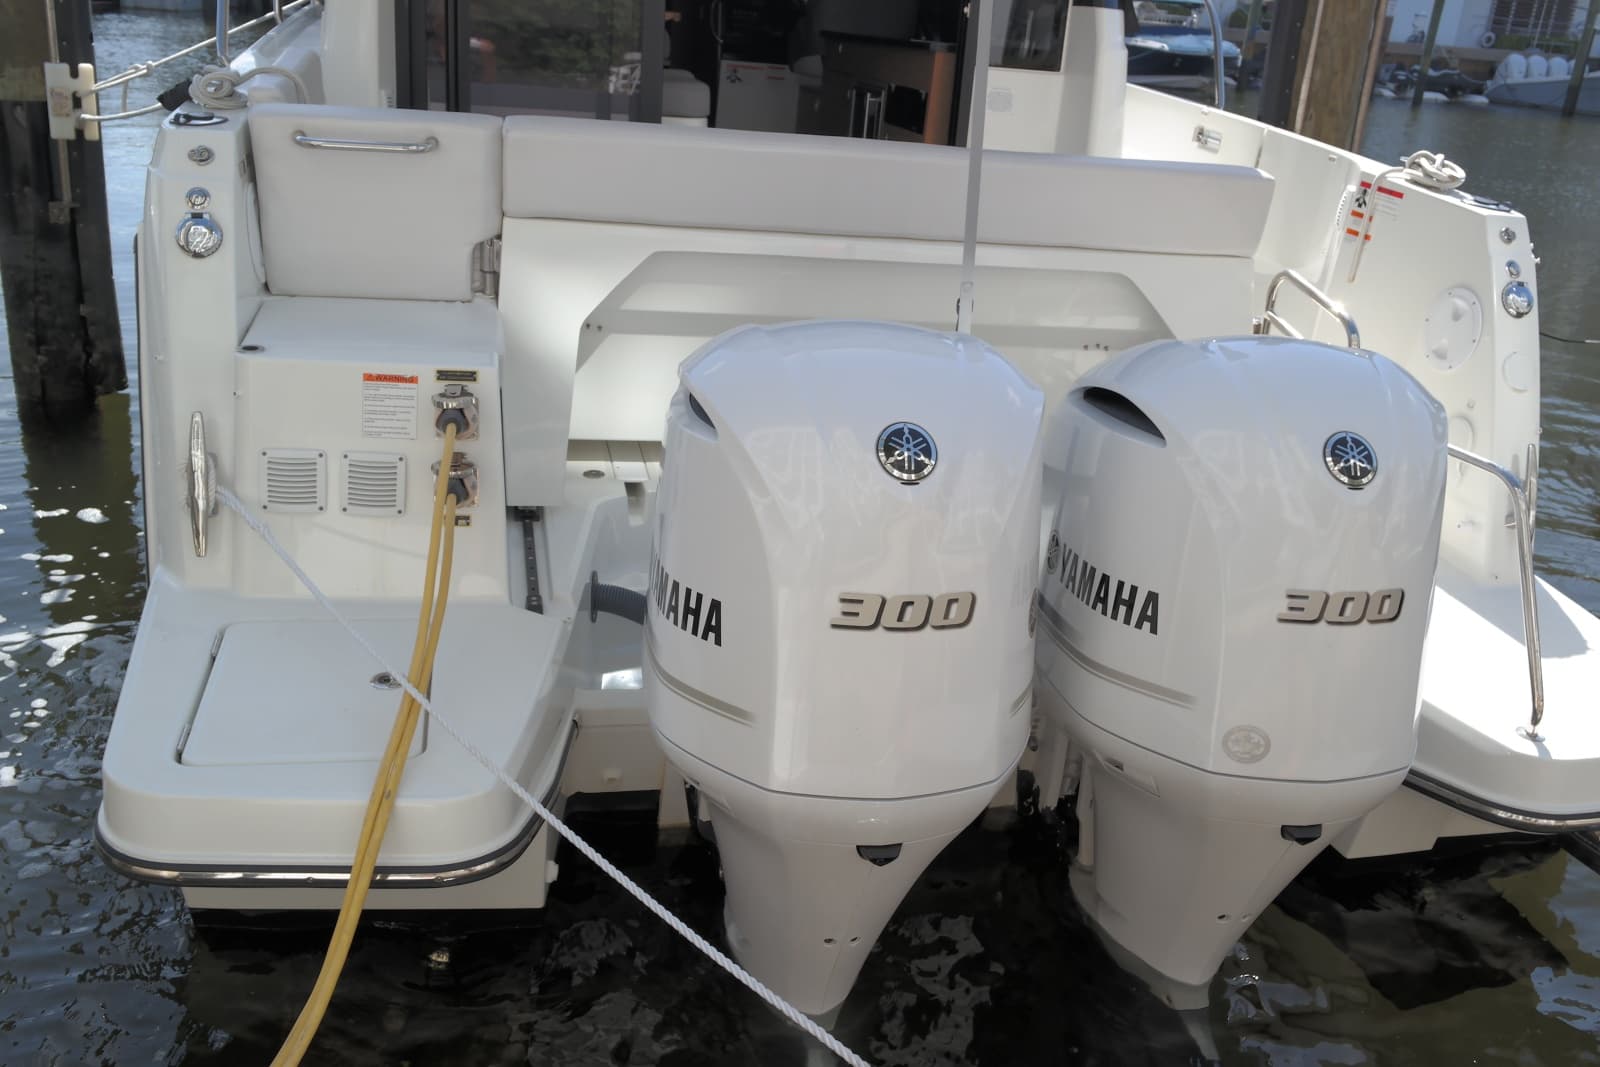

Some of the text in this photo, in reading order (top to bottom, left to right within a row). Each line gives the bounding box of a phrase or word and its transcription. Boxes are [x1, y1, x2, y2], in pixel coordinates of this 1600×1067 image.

[375, 374, 414, 384] WARNING
[1059, 544, 1160, 636] YAMAHA
[1277, 587, 1405, 626] 300
[830, 591, 977, 632] 300
